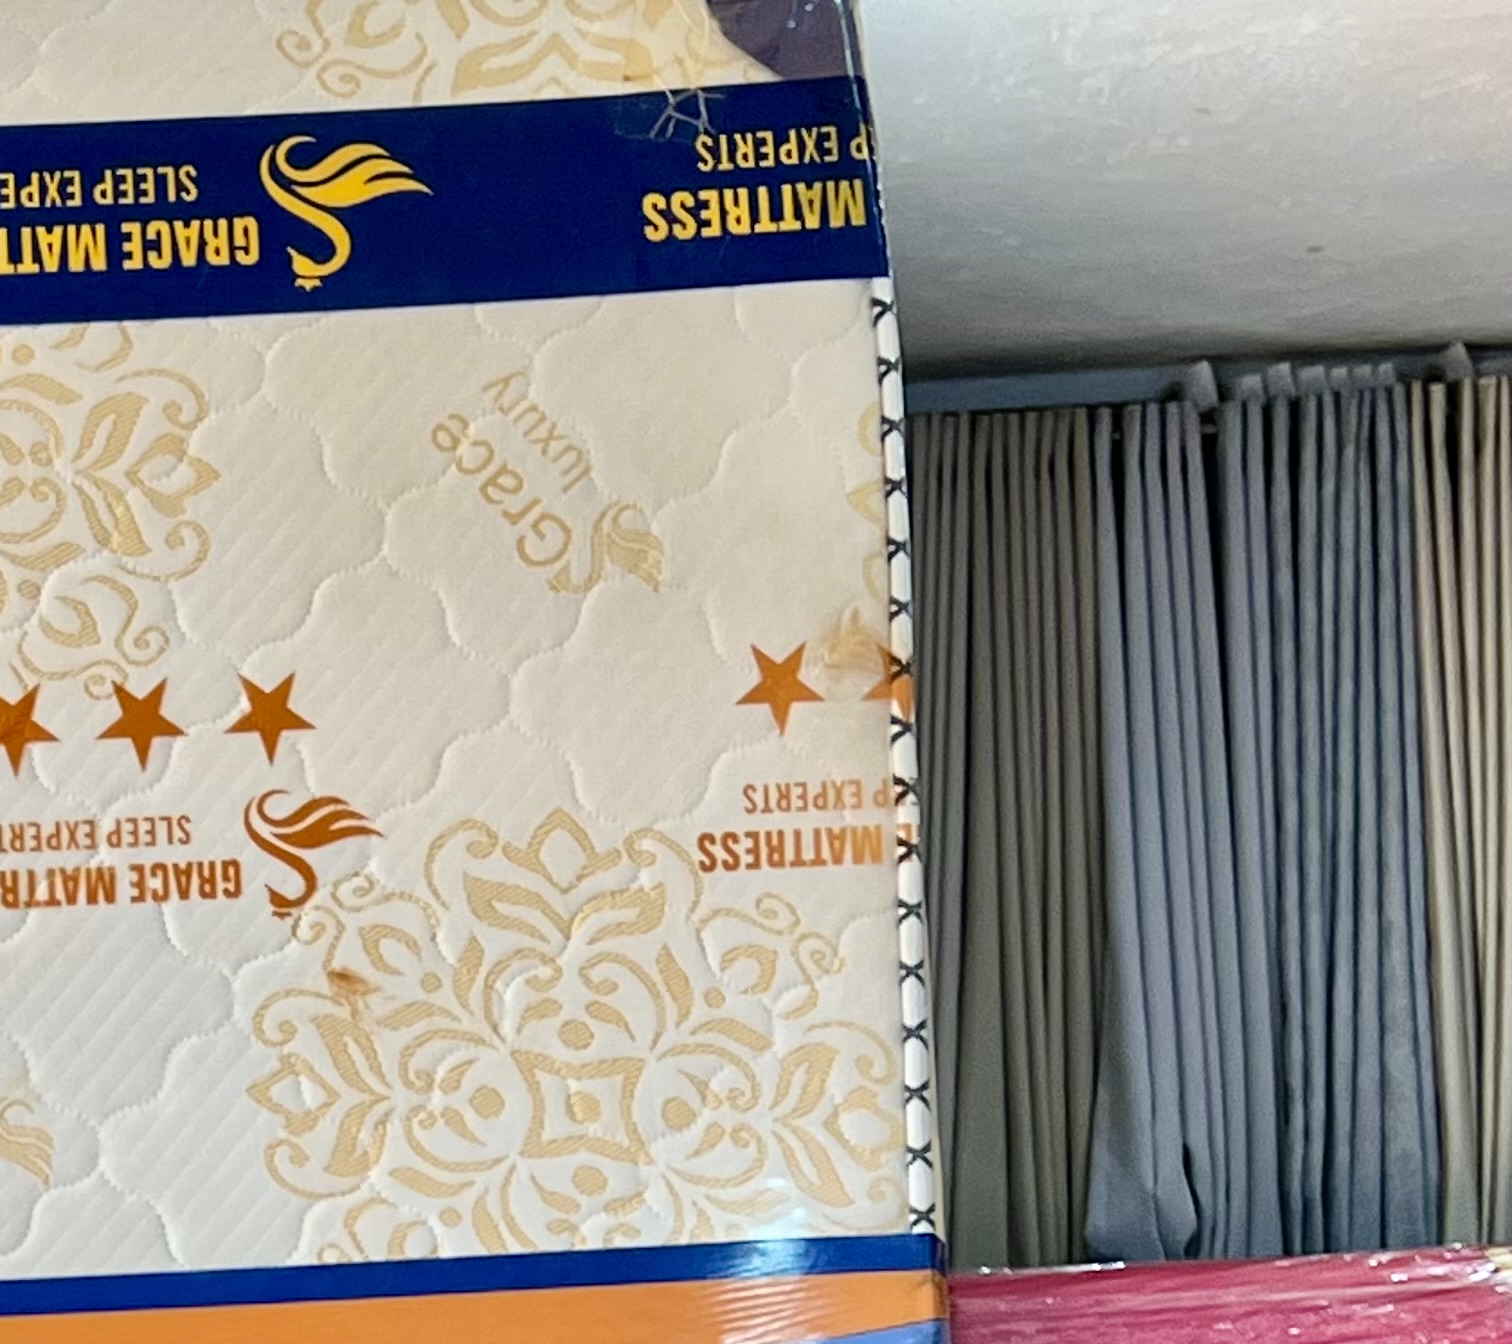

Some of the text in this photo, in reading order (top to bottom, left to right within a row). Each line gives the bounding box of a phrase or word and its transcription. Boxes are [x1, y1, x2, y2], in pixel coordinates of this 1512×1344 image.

[696, 125, 839, 171] EXPERTS
[94, 165, 197, 206] SLEEP
[641, 178, 867, 242] MATTRESS
[122, 216, 260, 270] GRACE
[482, 370, 593, 494] luxury
[431, 413, 573, 568] Grace
[743, 779, 863, 814] EXPERTS
[106, 815, 192, 848] SLEEP
[697, 824, 884, 873] MATTRESS
[130, 859, 242, 902] GRACE
